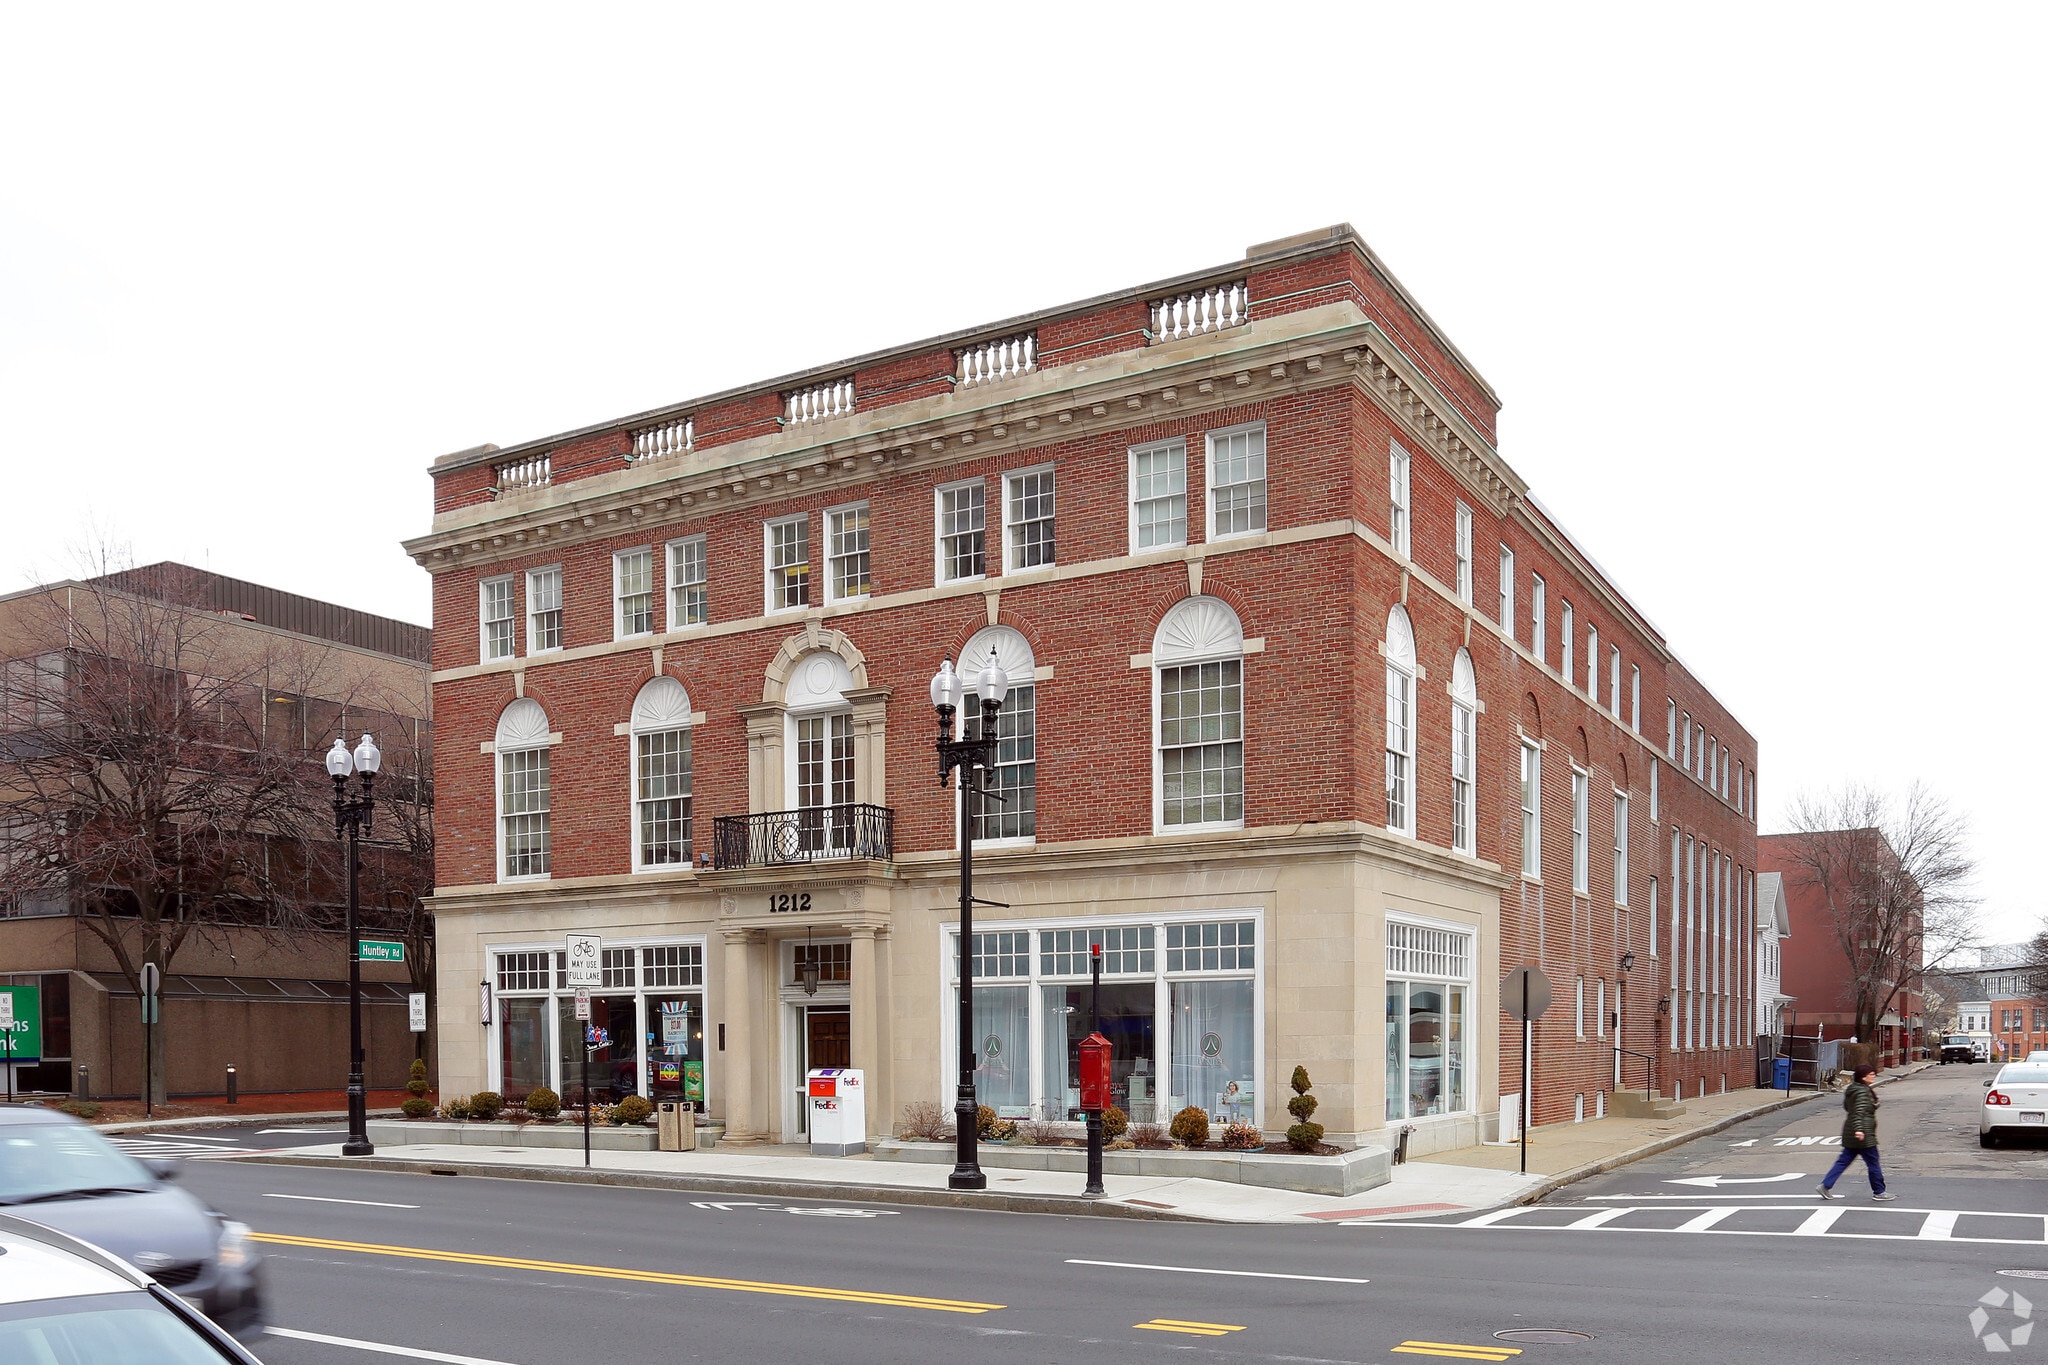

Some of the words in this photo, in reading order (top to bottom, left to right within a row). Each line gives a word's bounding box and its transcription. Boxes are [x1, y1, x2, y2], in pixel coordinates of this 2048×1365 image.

[769, 893, 812, 912] 1212
[362, 945, 389, 959] Huntley
[392, 949, 400, 957] Rd
[571, 960, 584, 969] MAY
[586, 960, 597, 969] USE
[569, 971, 583, 980] FULL
[585, 972, 600, 980] LANE
[843, 1077, 860, 1086] FedEx
[814, 1100, 837, 1110] FedEx
